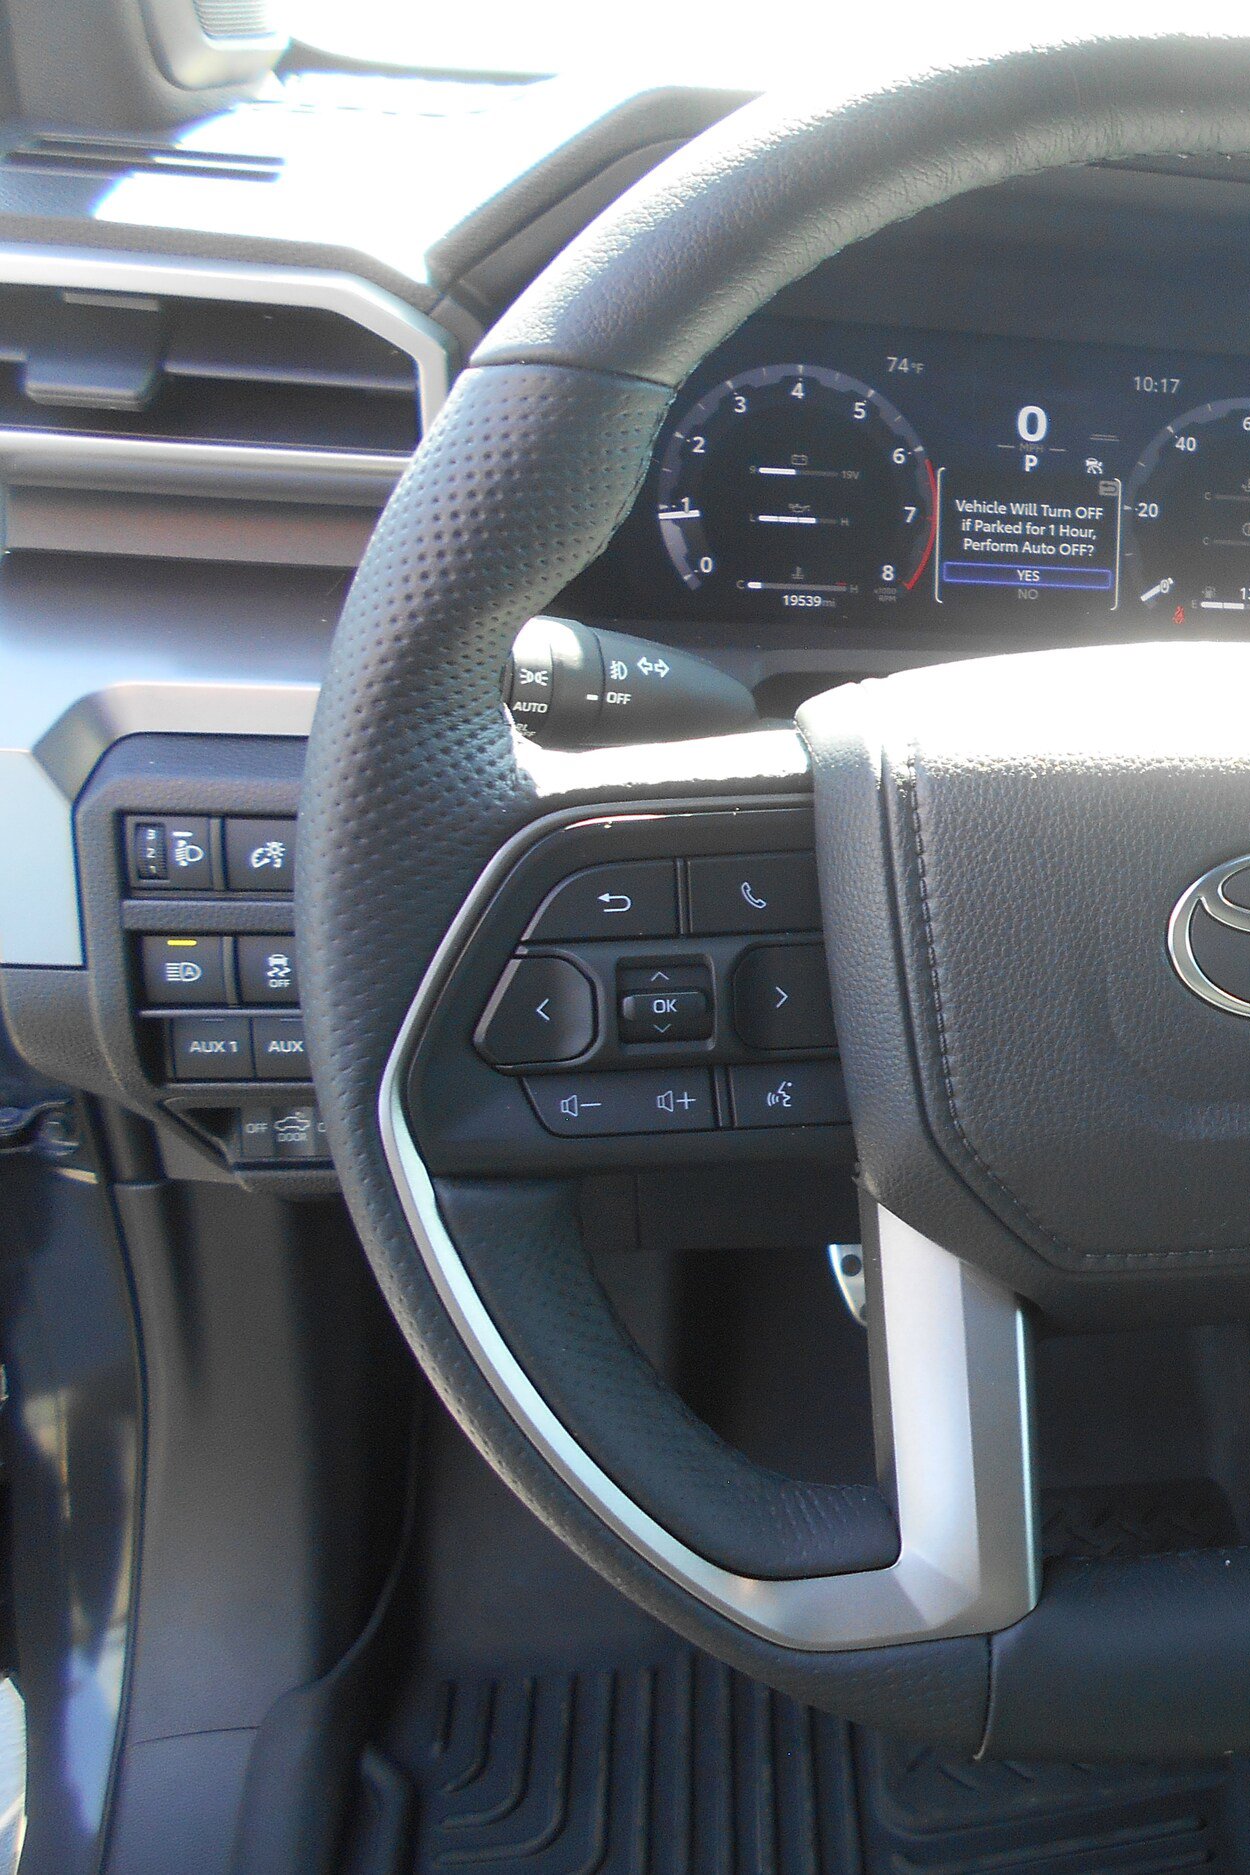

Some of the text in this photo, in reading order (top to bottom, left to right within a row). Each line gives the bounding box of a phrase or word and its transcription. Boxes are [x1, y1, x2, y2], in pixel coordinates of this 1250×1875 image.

[791, 383, 804, 399] 4
[1134, 376, 1180, 394] 10:17
[734, 397, 747, 413] 3
[854, 402, 866, 419] 5
[1017, 405, 1047, 442] 0
[692, 436, 705, 453] 2
[1175, 436, 1196, 452] 40
[892, 448, 906, 464] 6
[1024, 455, 1038, 471] P
[904, 507, 916, 523] 7
[956, 500, 1104, 520] Vehicle Will Turn OFF
[1138, 502, 1158, 518] 20
[961, 520, 971, 531] if
[975, 520, 1022, 535] Parked
[1026, 522, 1046, 535] for
[1048, 524, 1055, 536] 1
[963, 538, 1095, 557] Perform Auto OFF?
[701, 556, 713, 573] 0
[882, 564, 894, 581] 8
[1017, 570, 1040, 582] YES
[782, 594, 822, 607] 19539
[1017, 589, 1039, 600] NO
[606, 692, 632, 705] OFF
[512, 701, 548, 713] AUTO
[268, 979, 290, 988] OFF
[653, 999, 677, 1013] OK
[190, 1040, 238, 1053] AUX 1
[268, 1040, 304, 1053] AUX
[246, 1123, 268, 1133] OFF
[278, 1132, 308, 1142] DOOR
